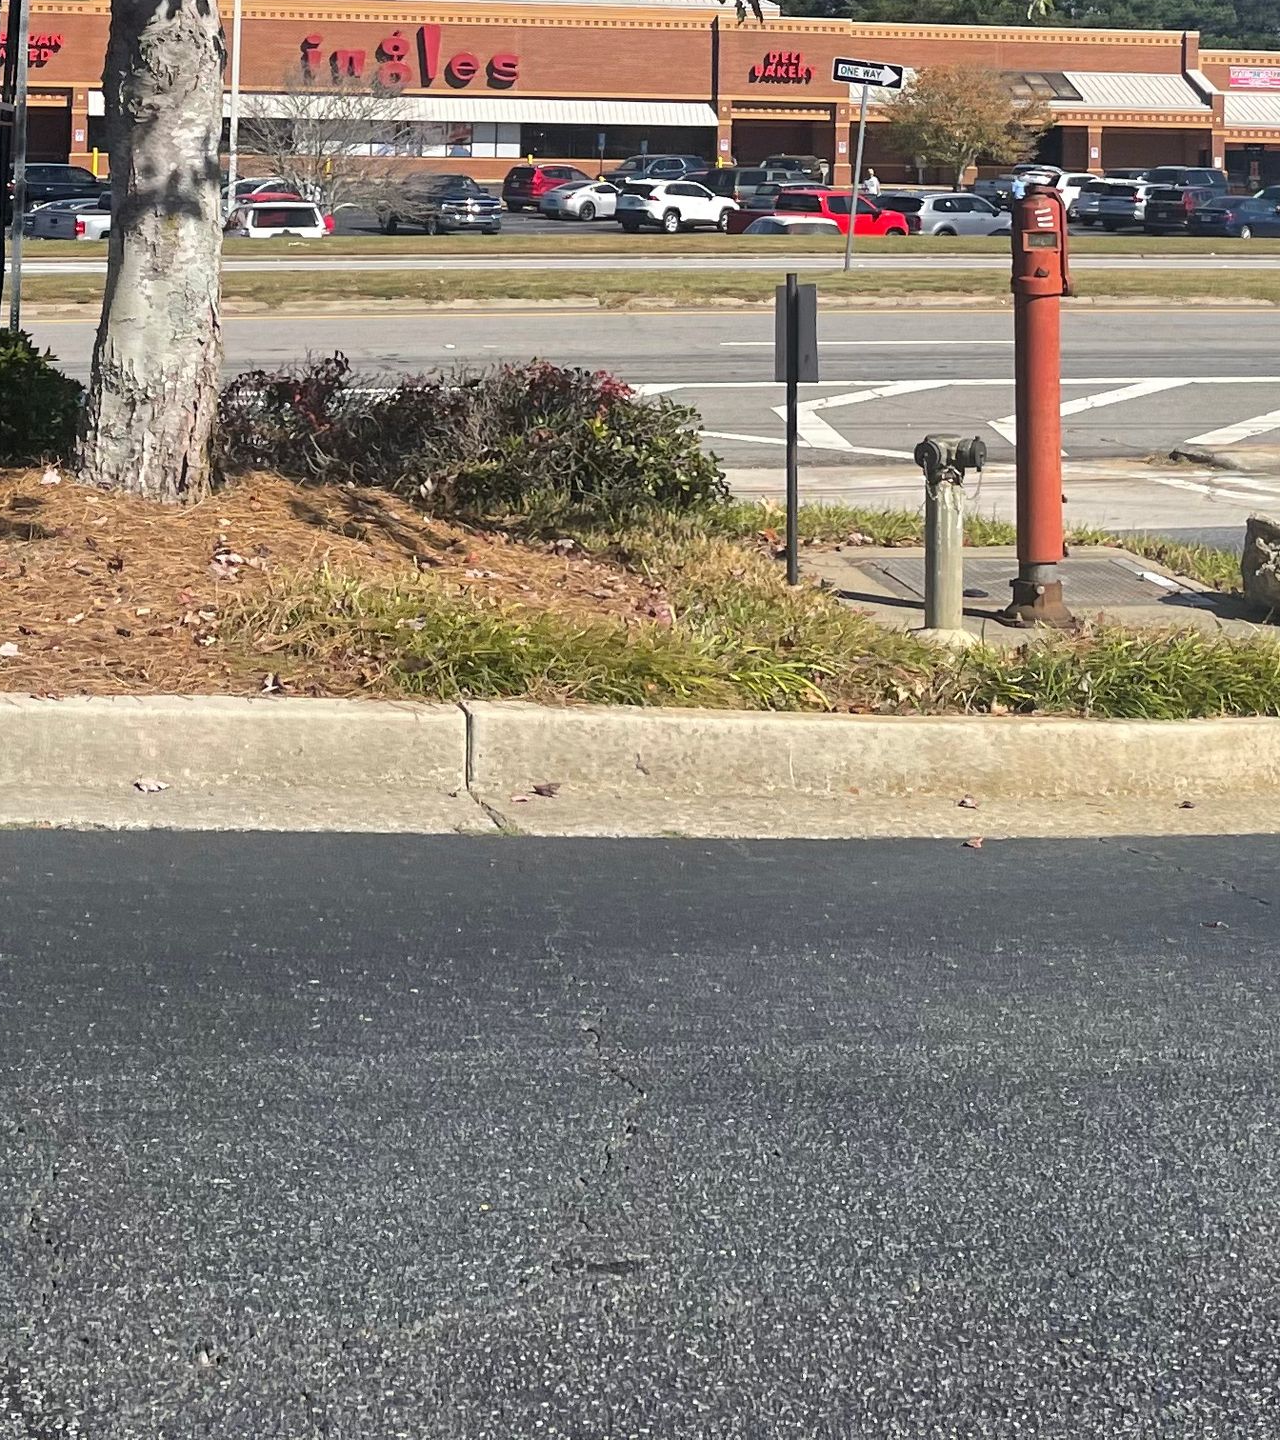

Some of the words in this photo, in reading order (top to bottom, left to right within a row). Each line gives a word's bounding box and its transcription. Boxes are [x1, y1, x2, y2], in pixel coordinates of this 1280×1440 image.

[305, 24, 520, 88] ingles
[769, 50, 805, 64] DELI
[754, 63, 817, 80] BAKERY
[840, 65, 859, 77] ONE
[862, 68, 882, 80] WAY
